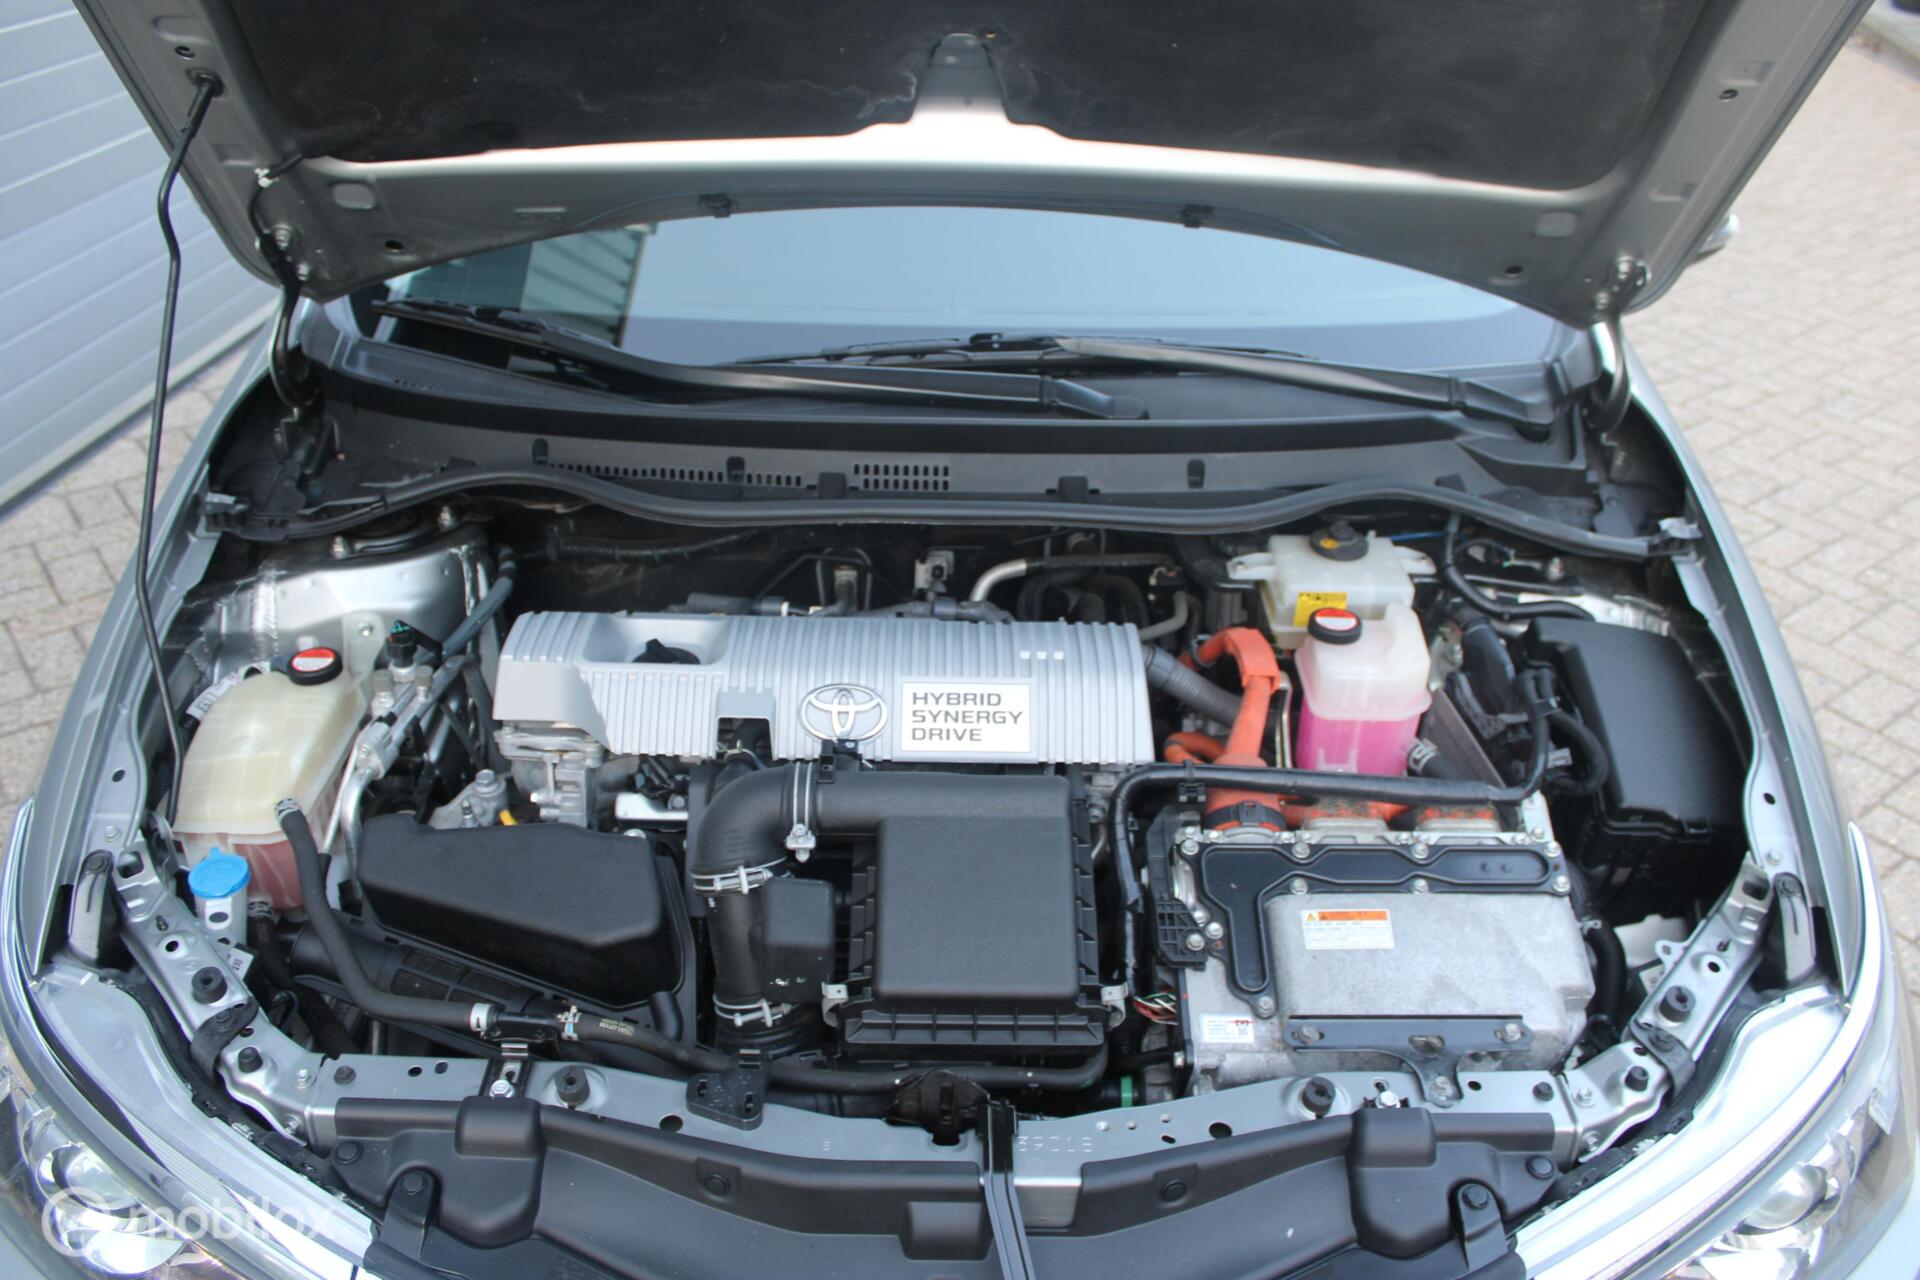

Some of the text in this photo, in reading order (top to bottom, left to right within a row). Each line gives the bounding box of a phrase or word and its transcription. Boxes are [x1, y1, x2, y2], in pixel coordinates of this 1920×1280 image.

[912, 692, 1002, 706] HYBRID
[912, 710, 1023, 724] SYNERGY
[912, 728, 982, 741] DRIVE
